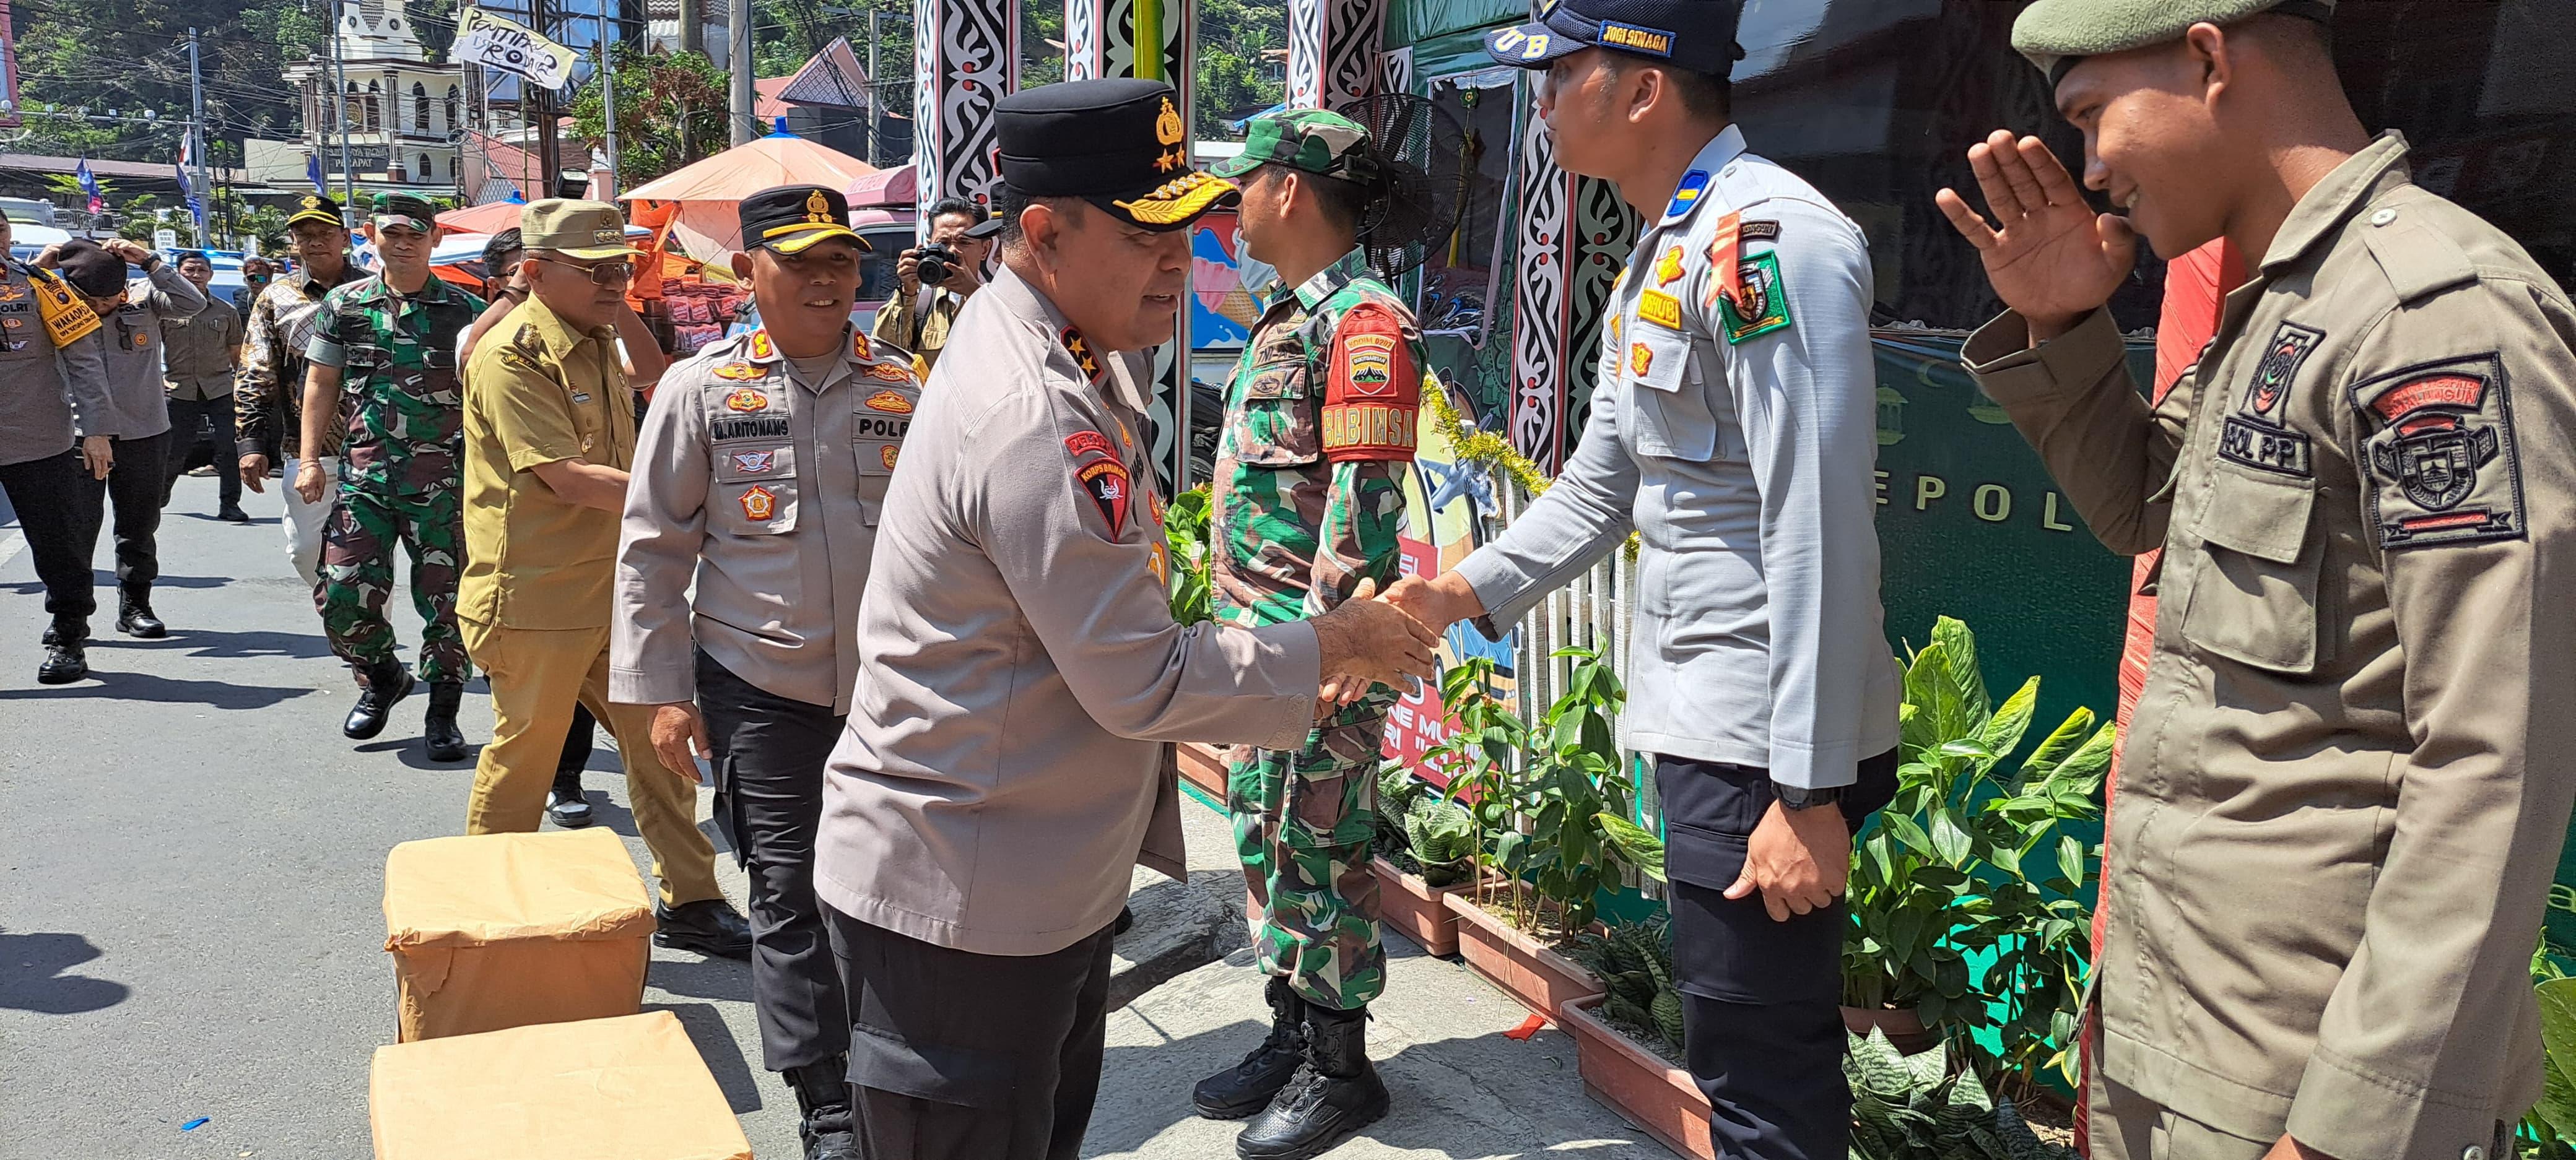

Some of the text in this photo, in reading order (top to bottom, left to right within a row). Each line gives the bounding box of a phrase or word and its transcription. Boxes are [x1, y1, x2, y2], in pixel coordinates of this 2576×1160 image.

[1489, 26, 1550, 60] UB
[1603, 25, 1668, 53] JOGI SINAGA
[335, 158, 372, 168] PAAPAT
[1347, 337, 1393, 348] KODIM 0207
[1323, 407, 1414, 448] BABINSA
[2258, 435, 2295, 464] PP
[1081, 464, 1103, 482] KORPS
